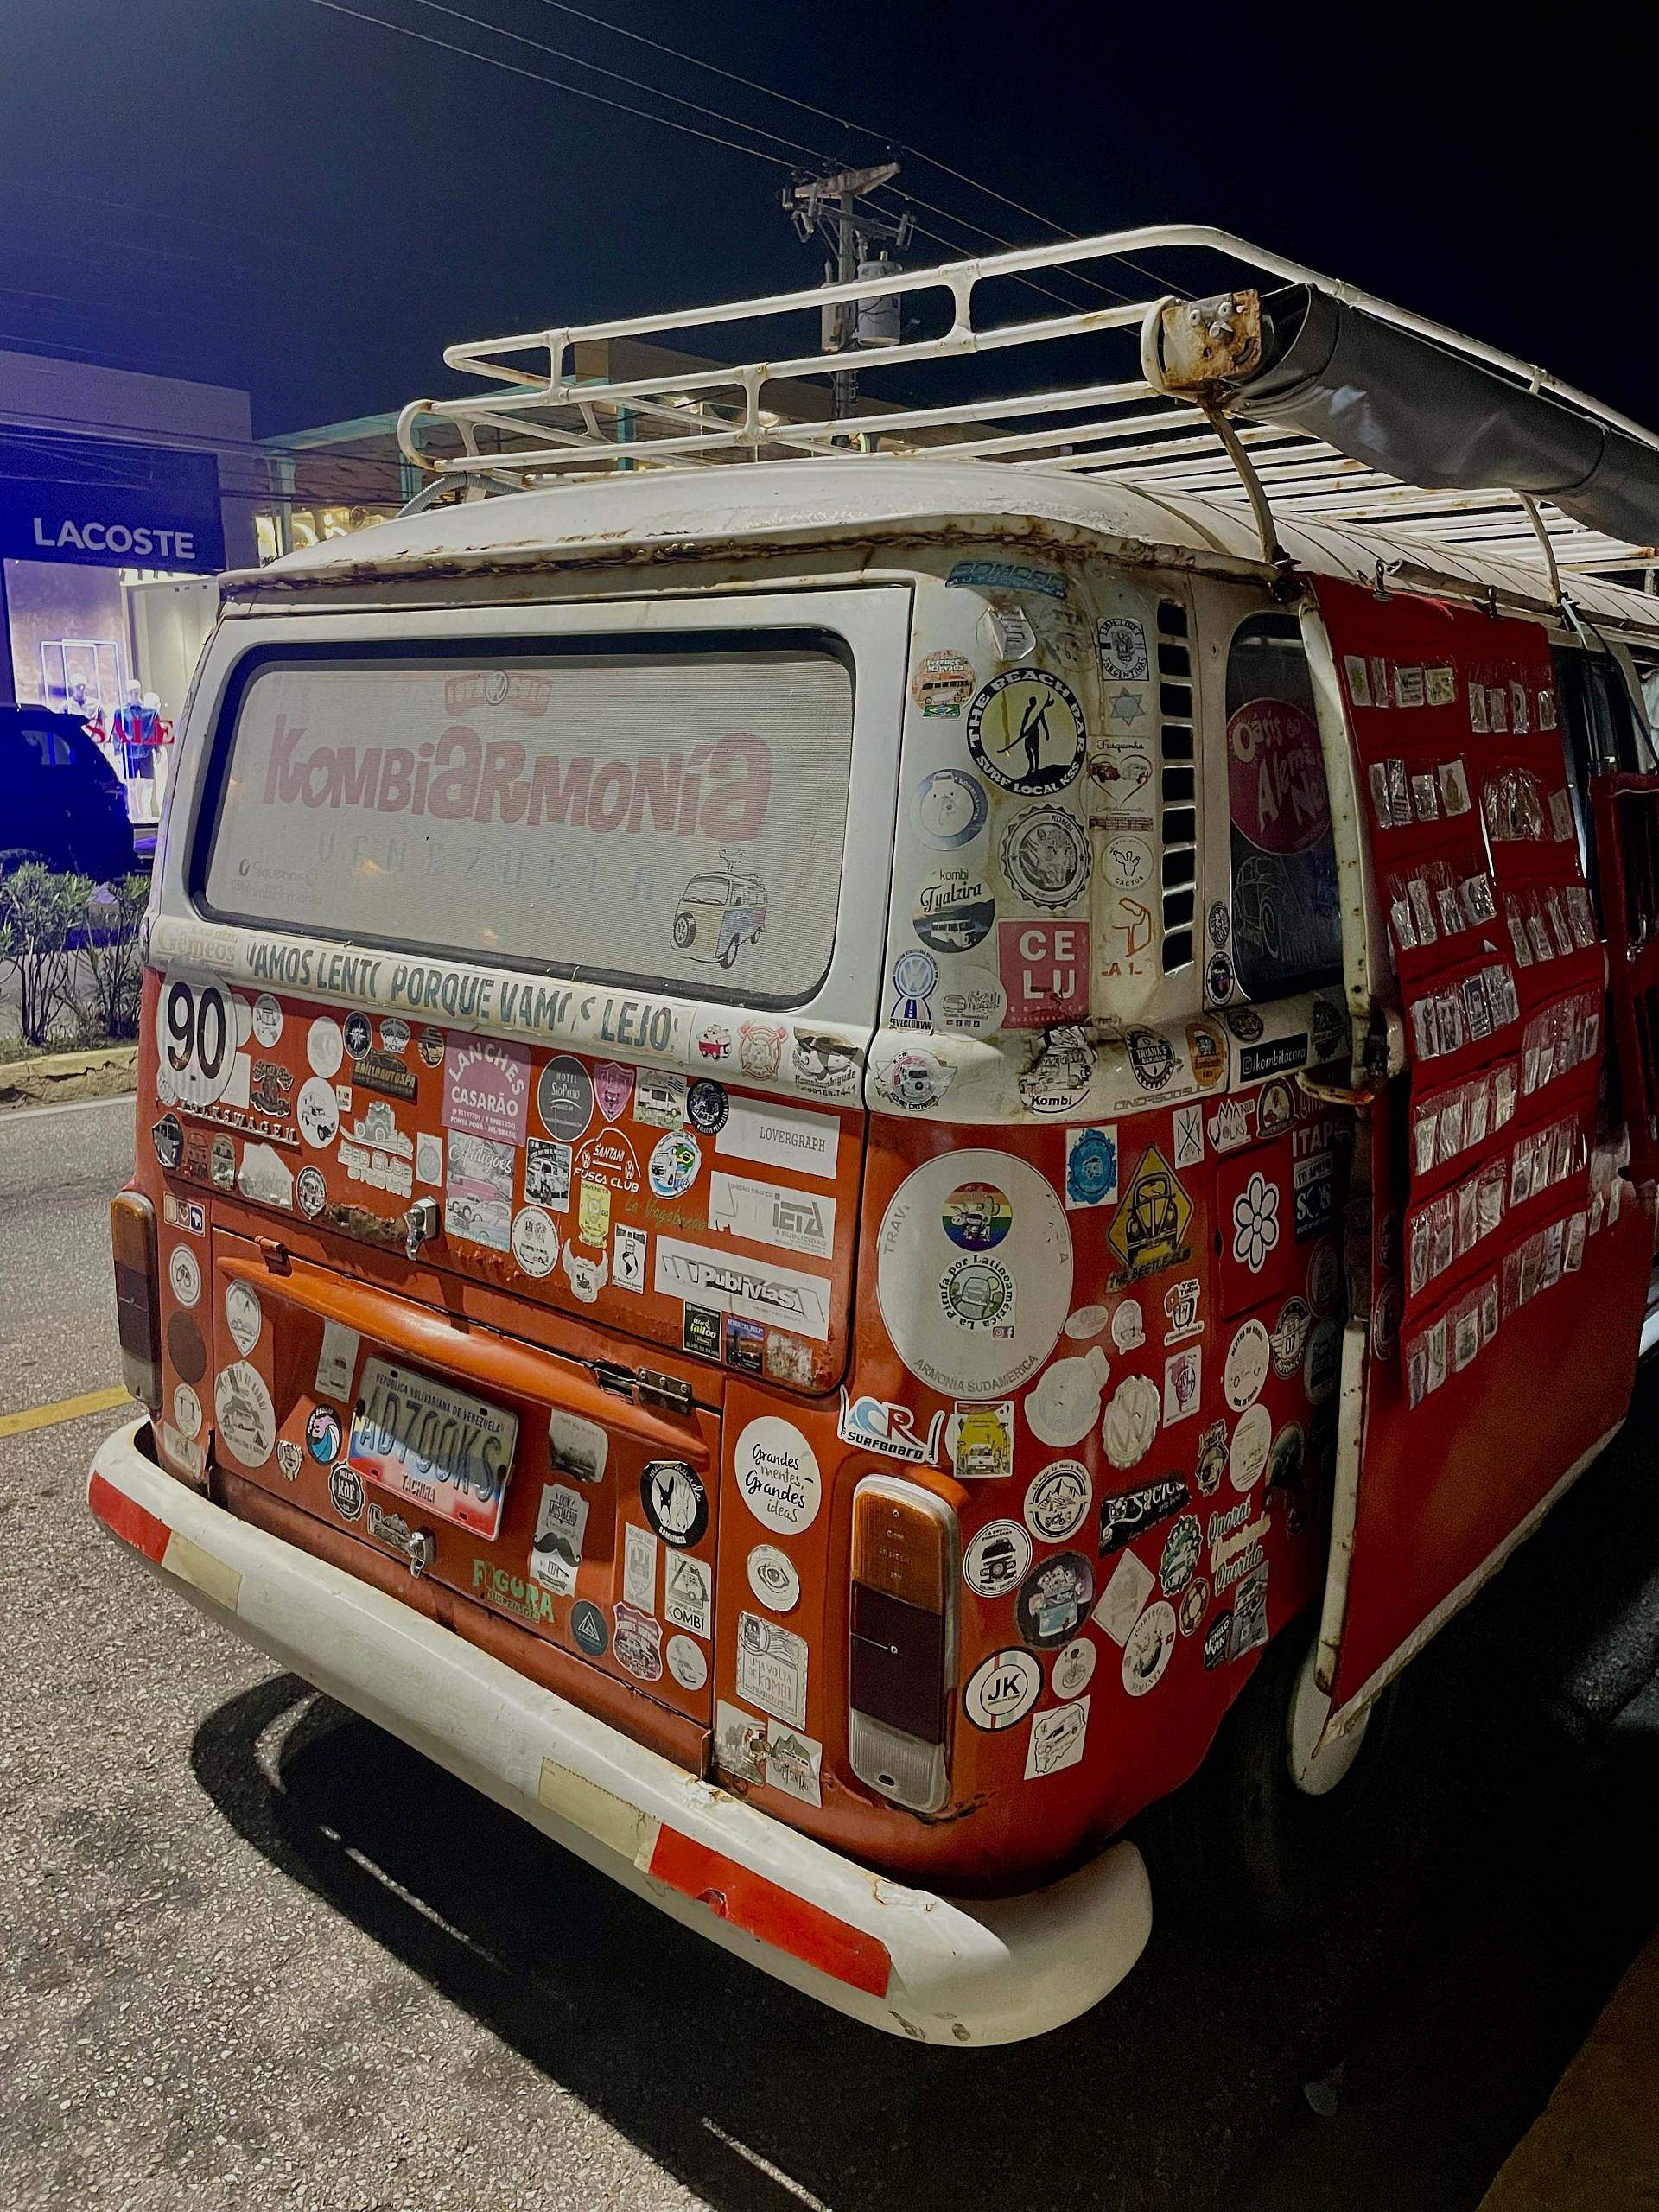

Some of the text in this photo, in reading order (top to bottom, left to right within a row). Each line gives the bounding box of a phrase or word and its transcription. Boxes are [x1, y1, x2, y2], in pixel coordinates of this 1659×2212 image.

[33, 518, 195, 560] LACOSTE
[969, 694, 992, 748] THE
[991, 669, 1071, 697] BEACH
[86, 717, 175, 746] SALE
[976, 756, 1012, 786] SURF
[1014, 781, 1059, 795] LOCAL
[939, 868, 969, 881] kombi
[1115, 875, 1145, 887] CACTUS
[391, 964, 494, 1018] PORQUE
[601, 999, 678, 1052] LEJO
[167, 981, 226, 1080] 90
[448, 1041, 525, 1096] LANCHES
[556, 1072, 577, 1084] HOTEL
[450, 1085, 518, 1117] CASARÃO
[1031, 1093, 1073, 1108] Kombi
[760, 1126, 826, 1154] LOVERGRAPH
[573, 1168, 640, 1193] FUSCA CLUB
[939, 1278, 957, 1321] Pitufa
[948, 1257, 969, 1276] por
[973, 1254, 1013, 1327] Latinoamérica
[452, 1405, 461, 1417] DE
[463, 1410, 501, 1433] VENEZUELA
[752, 1444, 799, 1471] Grandes
[745, 1470, 807, 1509] Grandes
[767, 1498, 798, 1523] ideas
[668, 1605, 705, 1631] KOMBI
[987, 1673, 1021, 1702] JK
